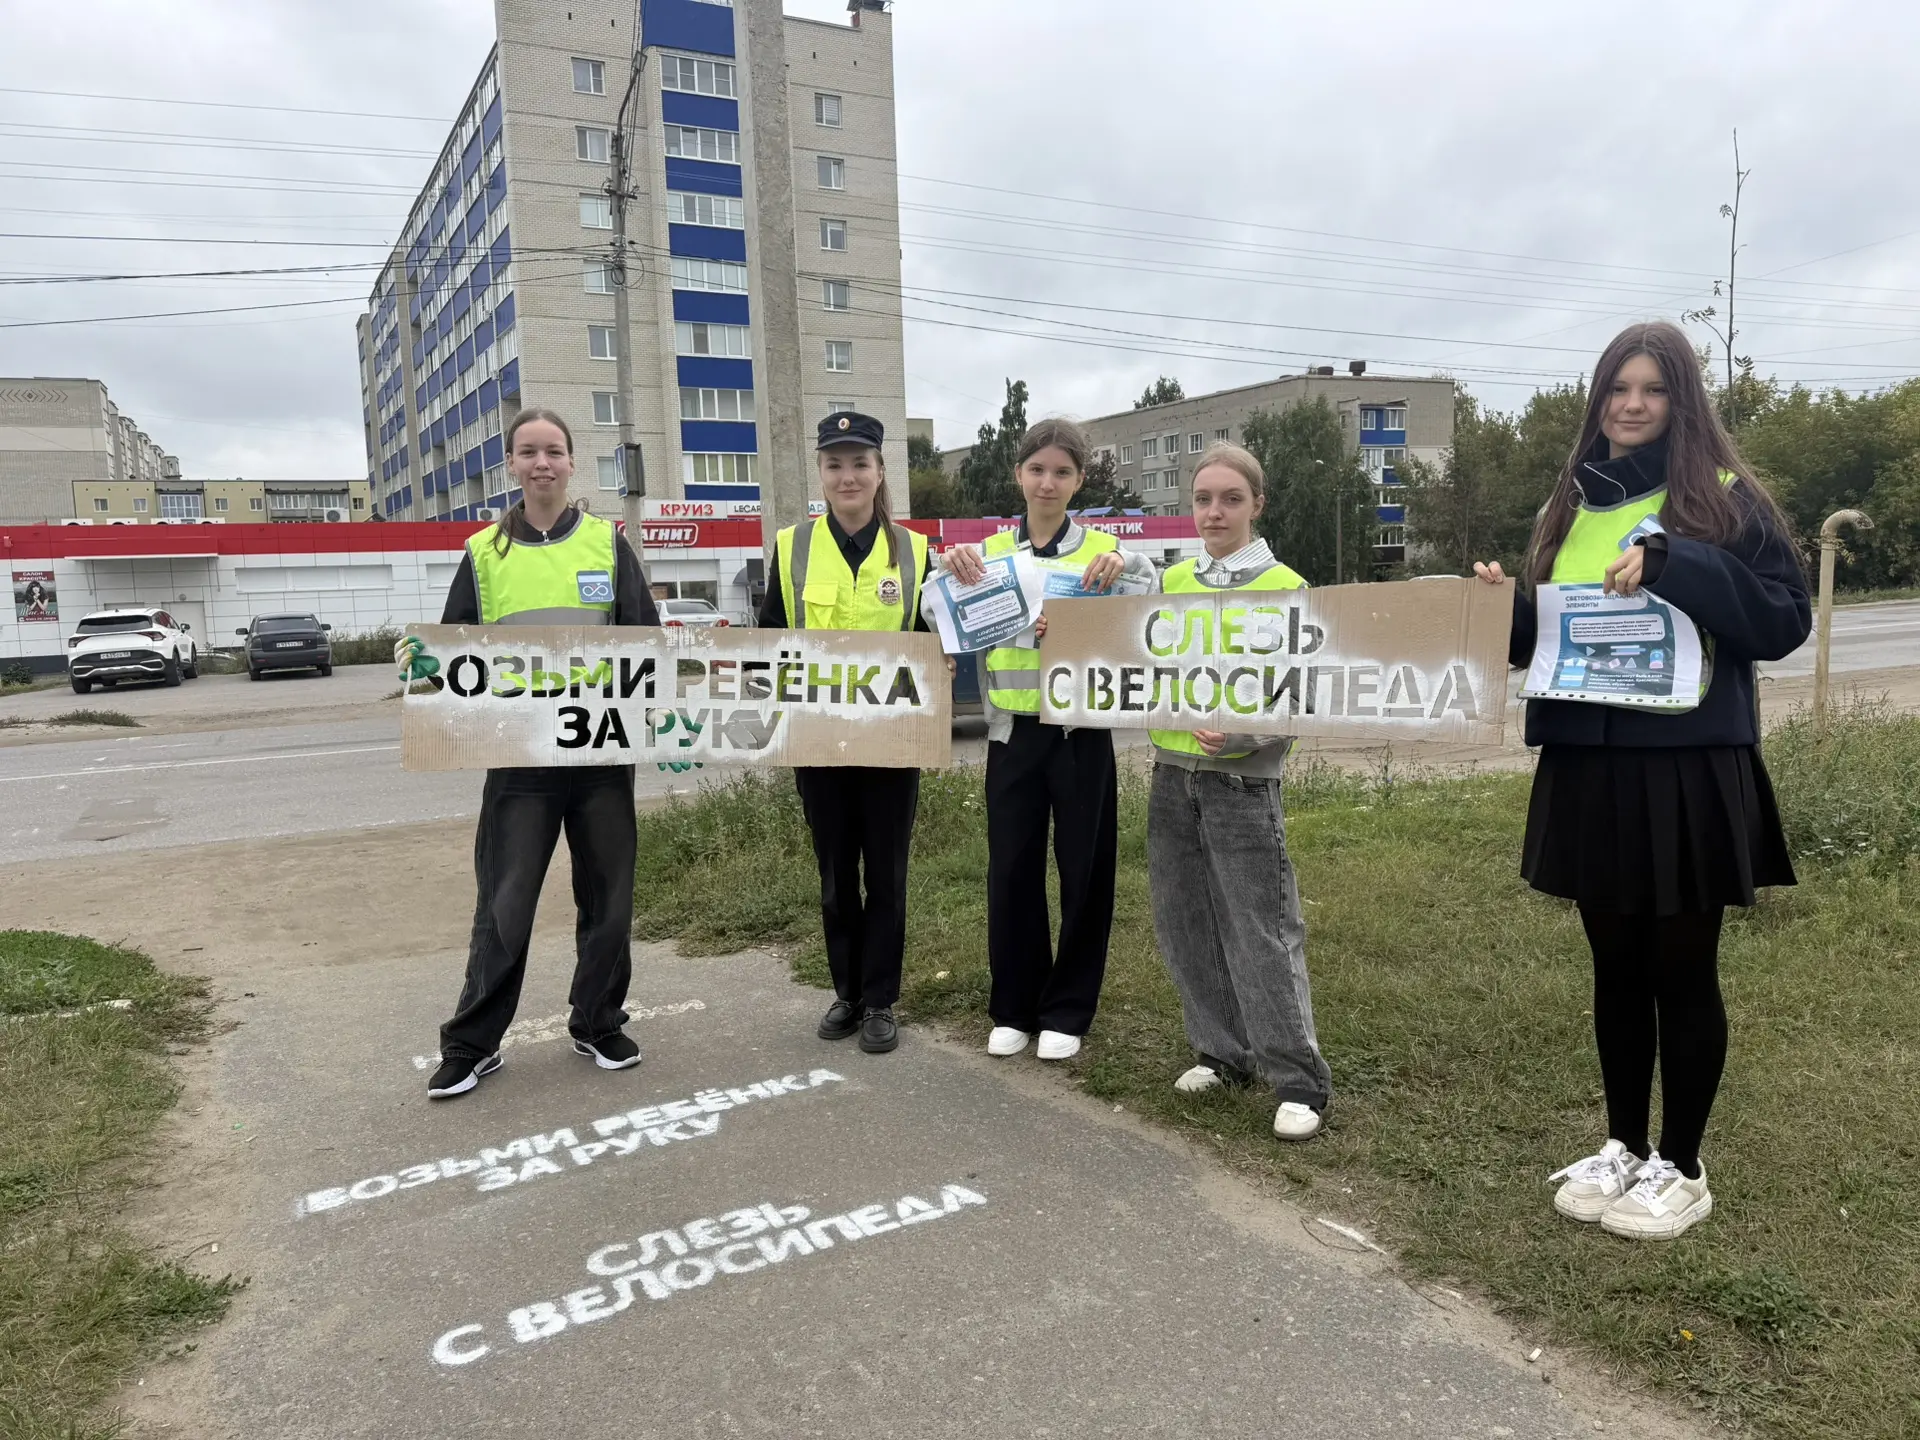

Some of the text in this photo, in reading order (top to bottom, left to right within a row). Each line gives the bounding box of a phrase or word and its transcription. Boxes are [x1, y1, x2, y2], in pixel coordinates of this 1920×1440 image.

[641, 528, 693, 541] АГНИТ
[660, 503, 714, 517] КРУИЗ
[1145, 606, 1325, 657] СЛЕЗЬ
[677, 651, 922, 706] РЕБЁНКА
[1049, 665, 1479, 720] С ВЕЛОСИПЕДА
[556, 705, 784, 750] ЗА РУКУ
[300, 1068, 845, 1214] ВОЗЬМИ РЕБЁНКА
[476, 1112, 721, 1192] ЗА РУКУ
[586, 1202, 811, 1275] СЛЕЗЬ
[431, 1184, 988, 1365] С ВЕЛОСИПЕДА
